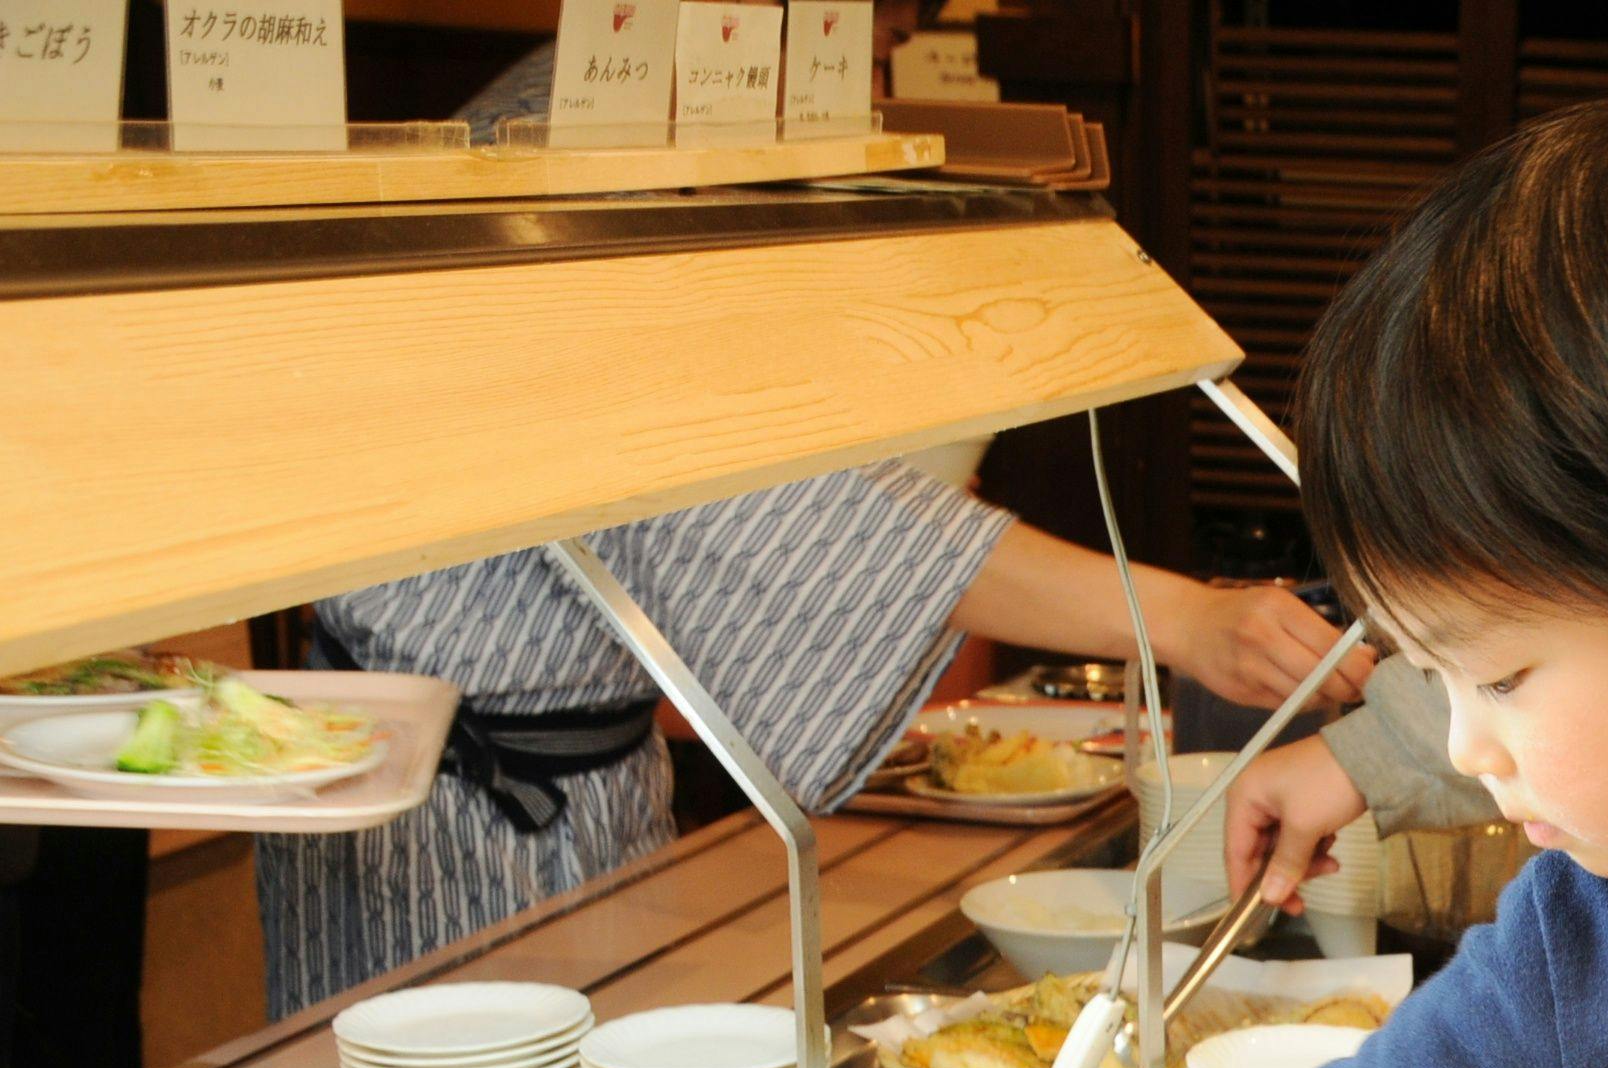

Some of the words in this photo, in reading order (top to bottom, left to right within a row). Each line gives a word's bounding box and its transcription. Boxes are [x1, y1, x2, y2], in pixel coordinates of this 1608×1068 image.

[180, 10, 328, 46] オクラの胡麻和え
[584, 54, 649, 84] あんみつ
[688, 65, 771, 90] コンニャク饅頭
[809, 54, 848, 82] ケーキ
